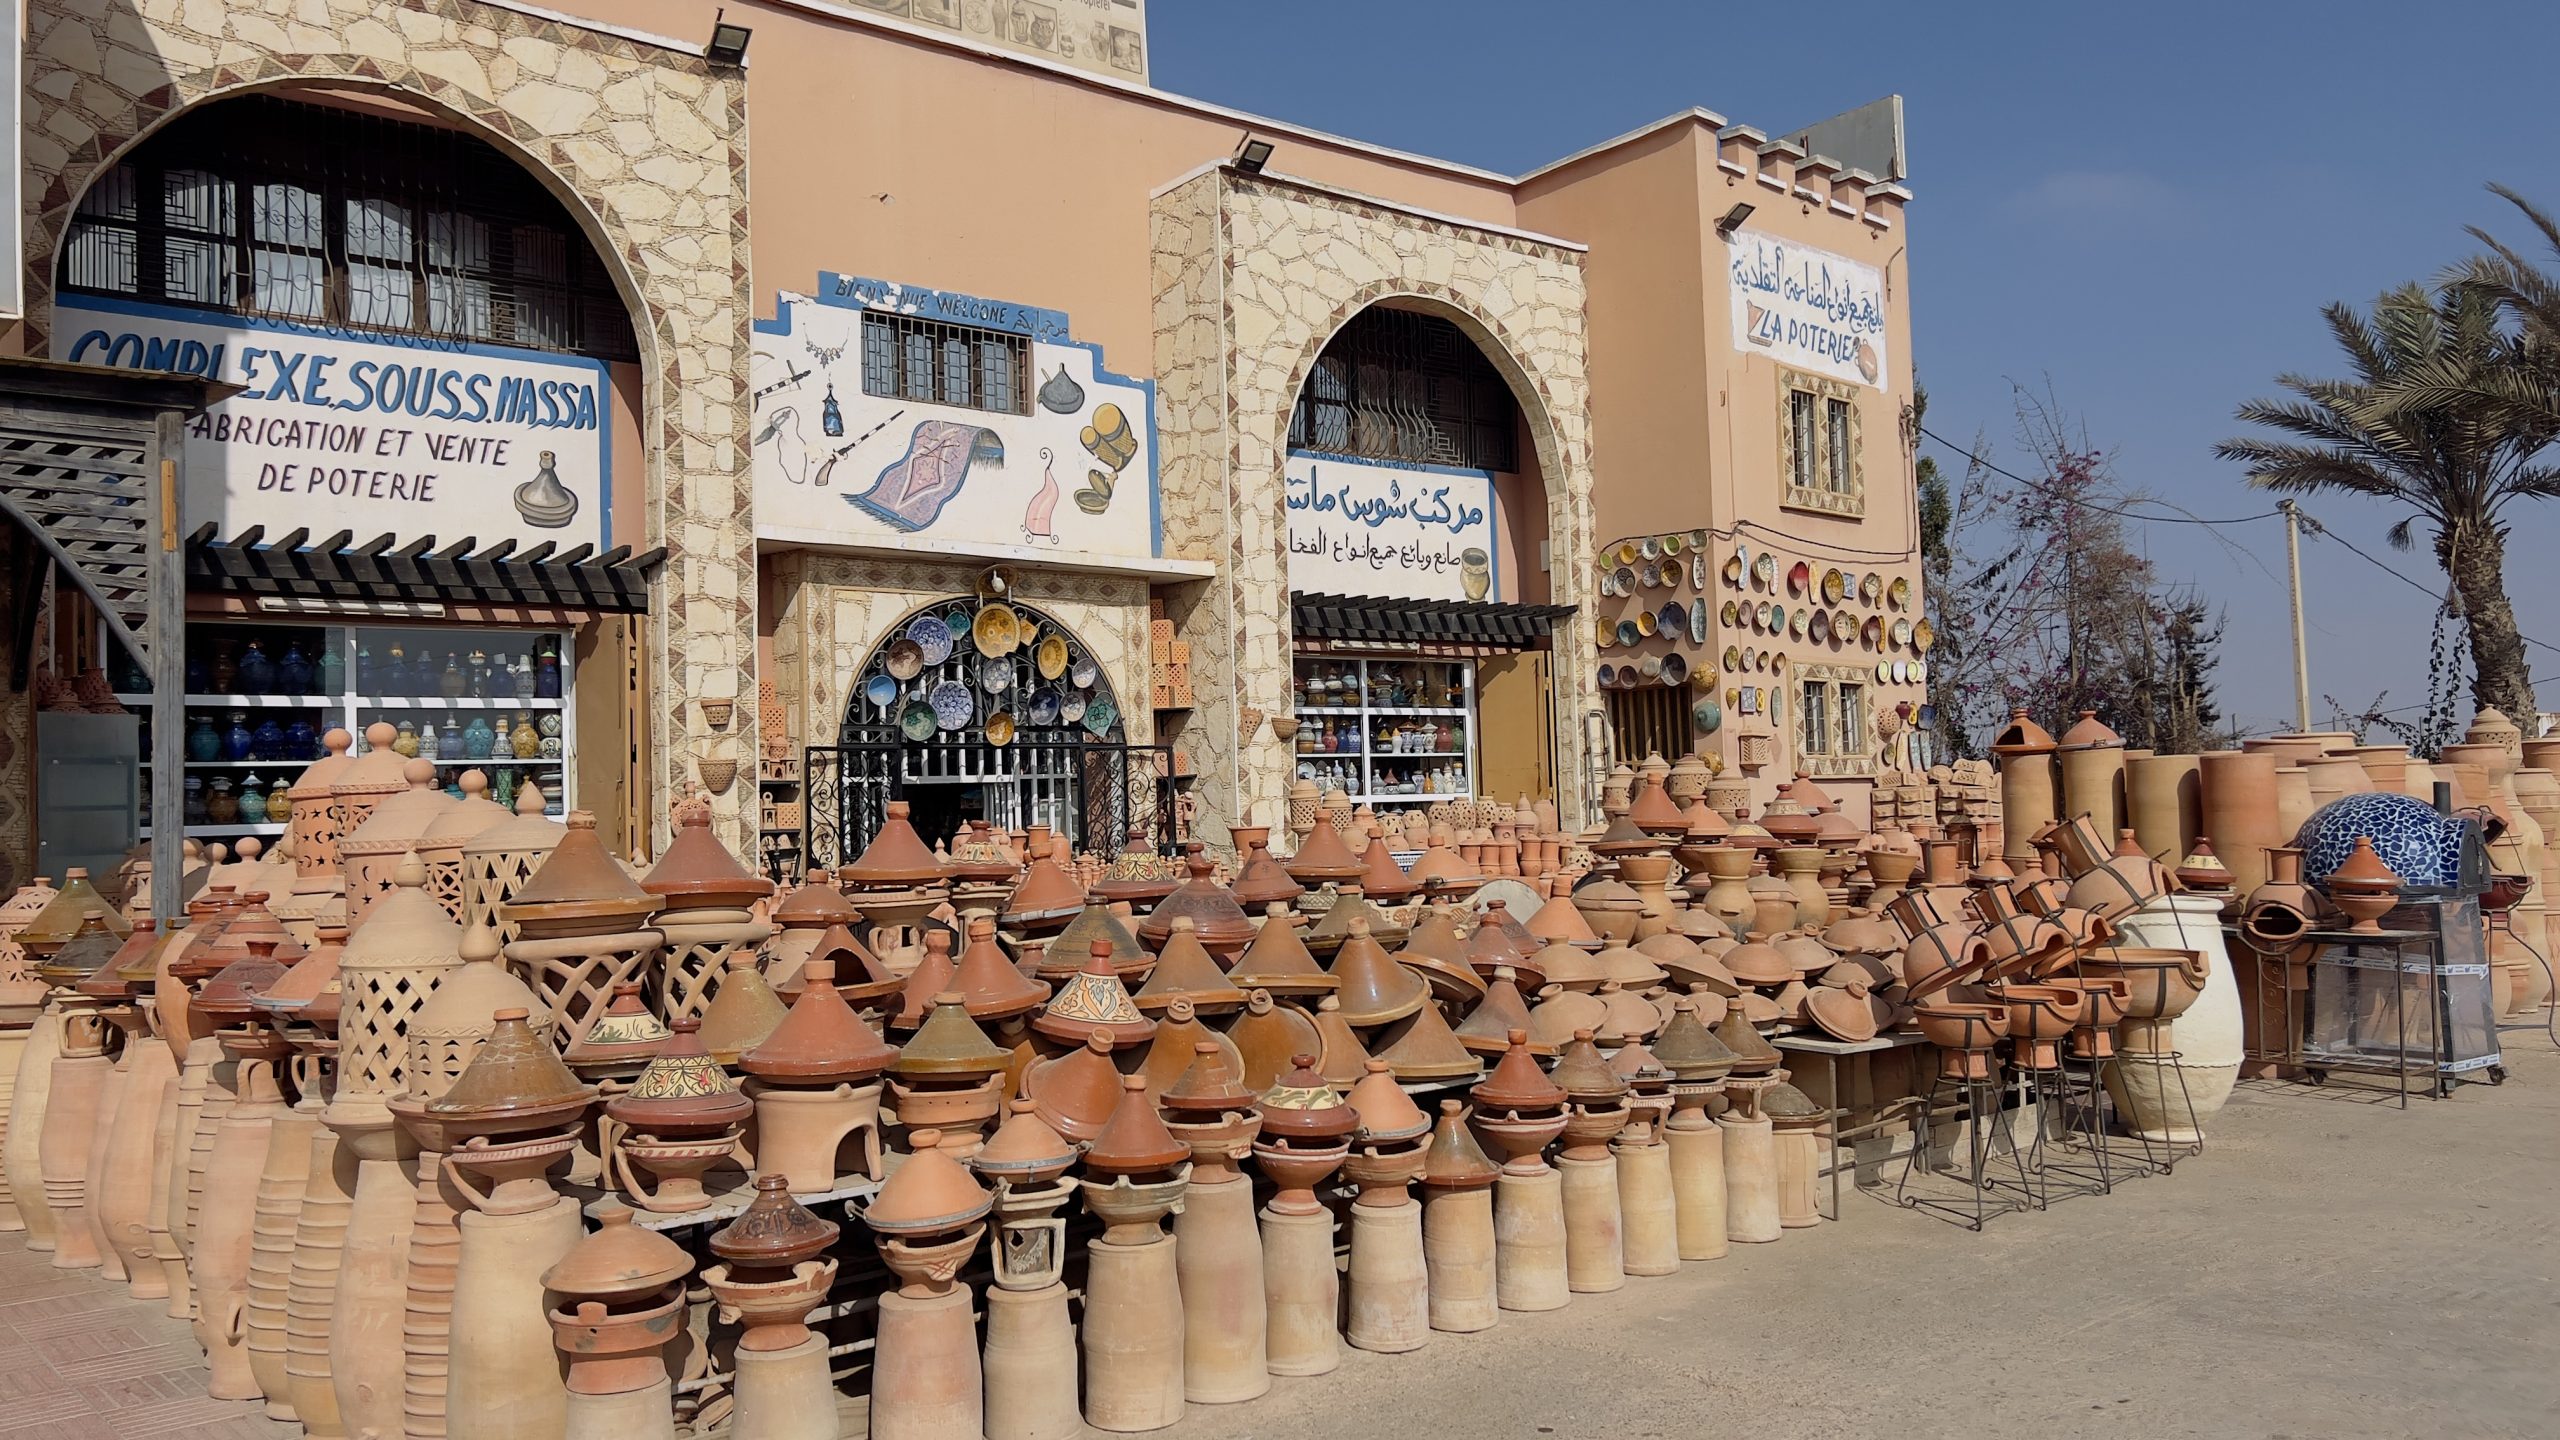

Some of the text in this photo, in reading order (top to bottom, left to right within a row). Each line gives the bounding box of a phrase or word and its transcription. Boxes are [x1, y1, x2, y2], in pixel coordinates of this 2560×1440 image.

[936, 297, 1008, 325] WELCOME
[1760, 310, 1853, 364] LA POTERIE
[494, 375, 597, 431] MASSA
[185, 411, 513, 467] ABRICATION ET VENTE
[257, 463, 439, 503] DE POTERIE
[1289, 526, 1327, 556] الفخا
[1370, 545, 1398, 570] جميع
[1434, 541, 1461, 574] صانع
